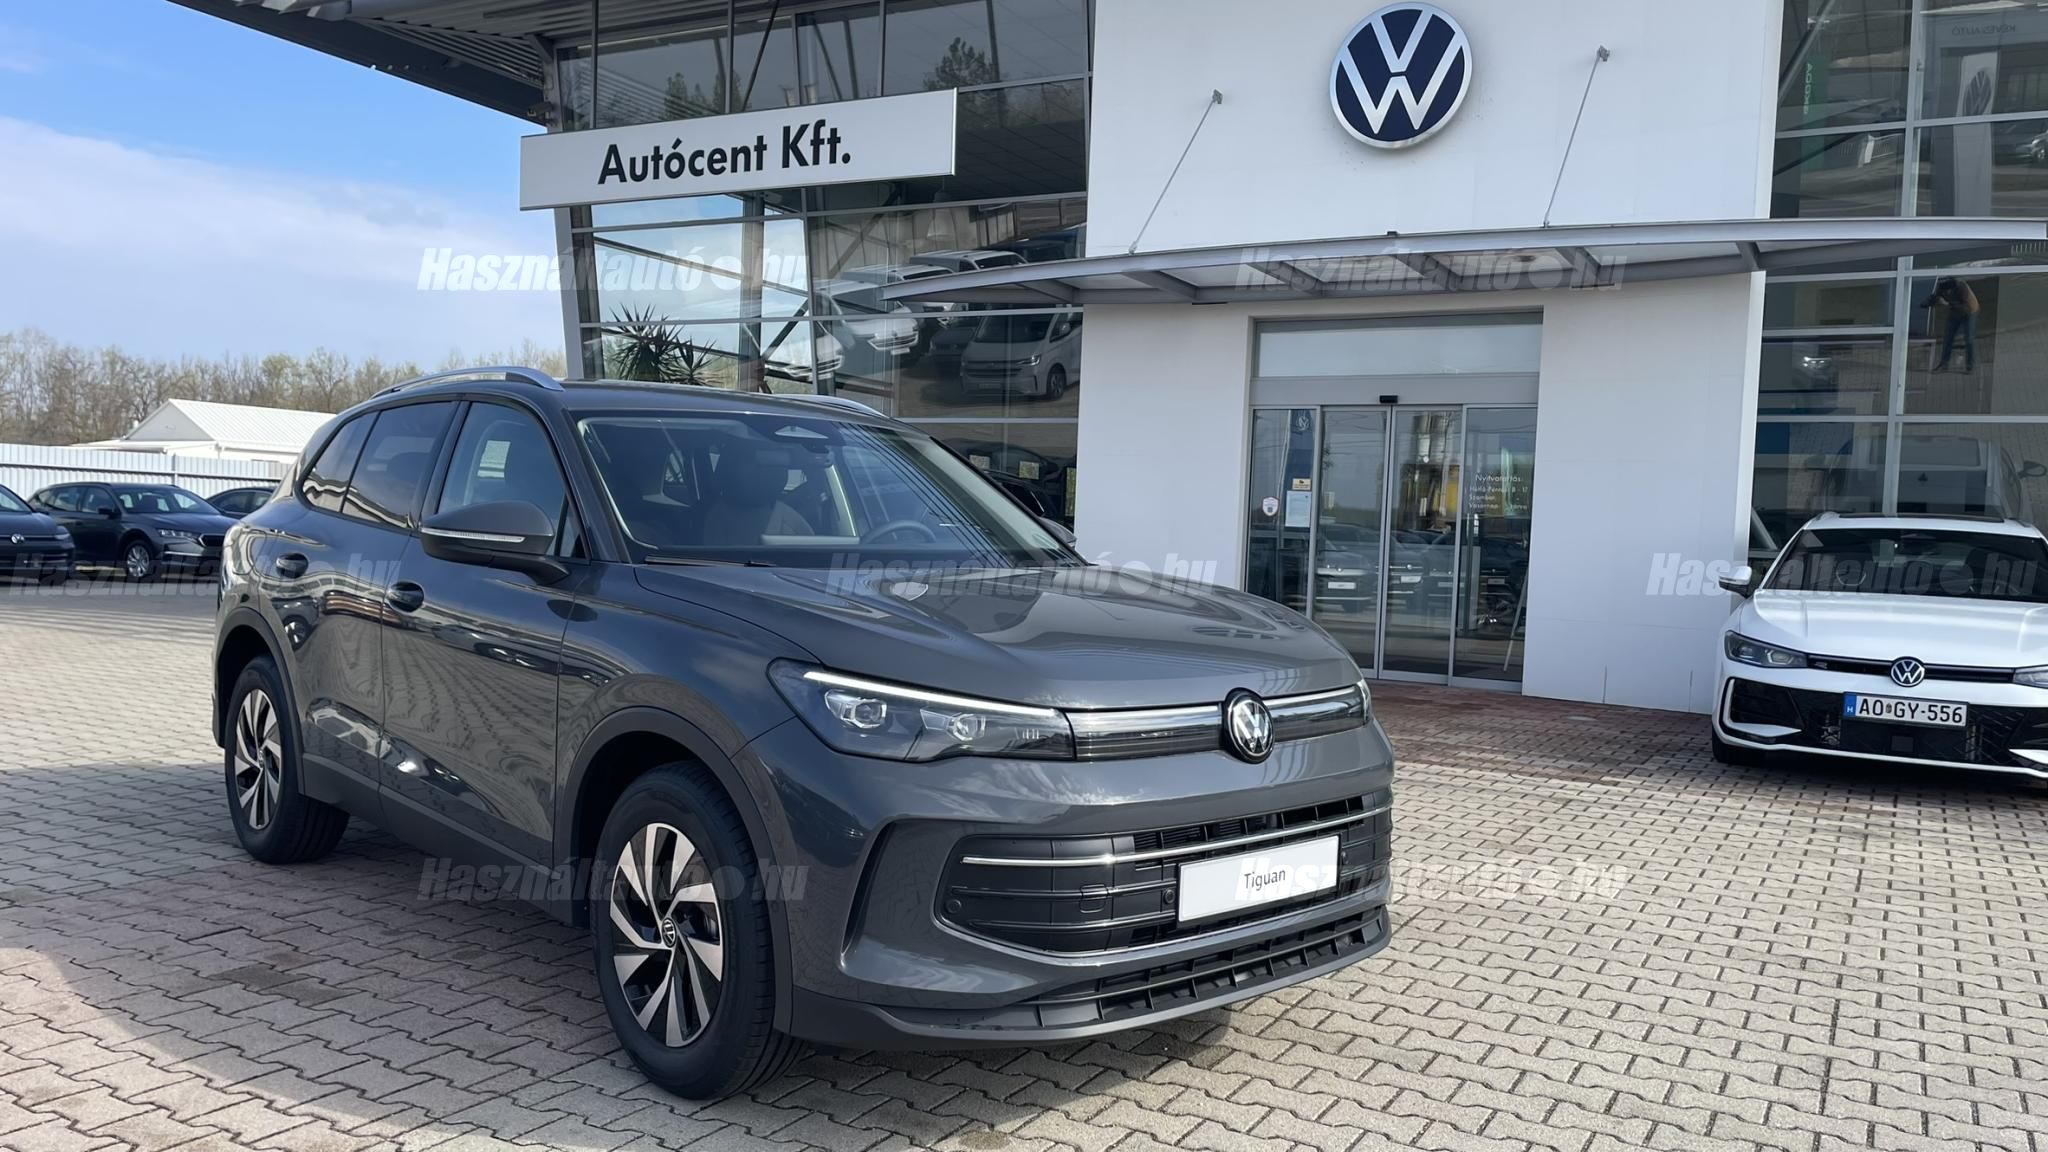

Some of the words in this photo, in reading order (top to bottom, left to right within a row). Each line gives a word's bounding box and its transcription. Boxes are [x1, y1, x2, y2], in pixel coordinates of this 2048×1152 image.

[597, 136, 768, 185] Autócent
[781, 119, 852, 168] Kft.
[1243, 869, 1286, 892] Tiguan
